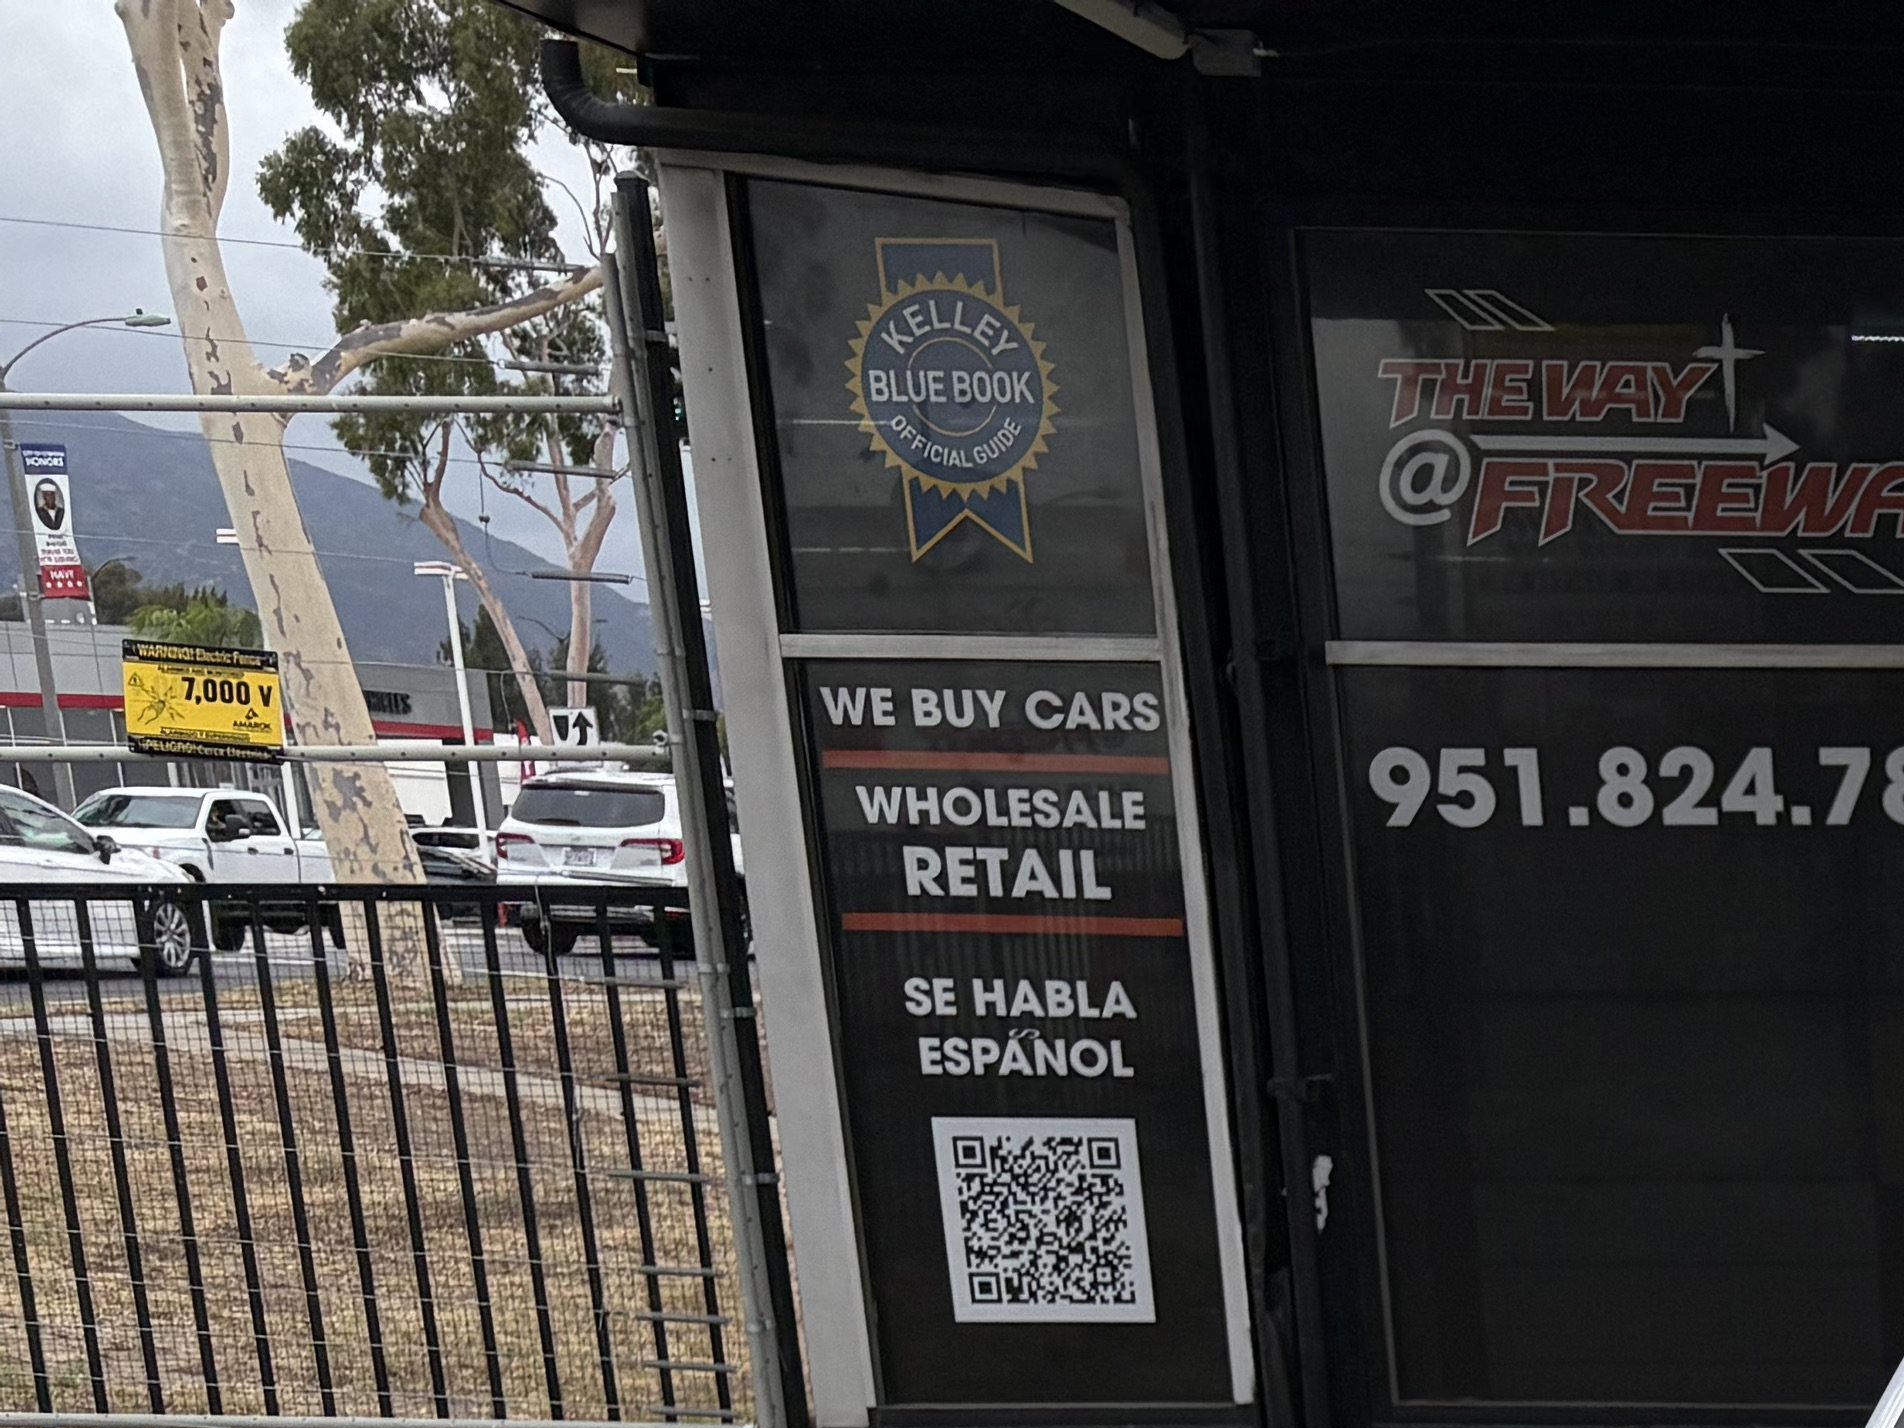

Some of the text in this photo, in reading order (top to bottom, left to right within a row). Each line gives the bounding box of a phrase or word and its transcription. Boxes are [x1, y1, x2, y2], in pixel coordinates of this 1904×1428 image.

[881, 299, 1019, 356] KELLEY
[868, 369, 1035, 404] BLUE BOOK
[1378, 358, 1718, 429] THE WAY
[891, 414, 1022, 468] OFFICIAL GUIDE
[181, 676, 272, 707] 7,000 V
[819, 687, 1160, 731] WE BUY CARS
[233, 720, 271, 730] AMAROK
[855, 785, 1147, 830] WHOLESALE
[902, 845, 1112, 900] RETAIL
[904, 976, 1138, 1020] SE HABLA
